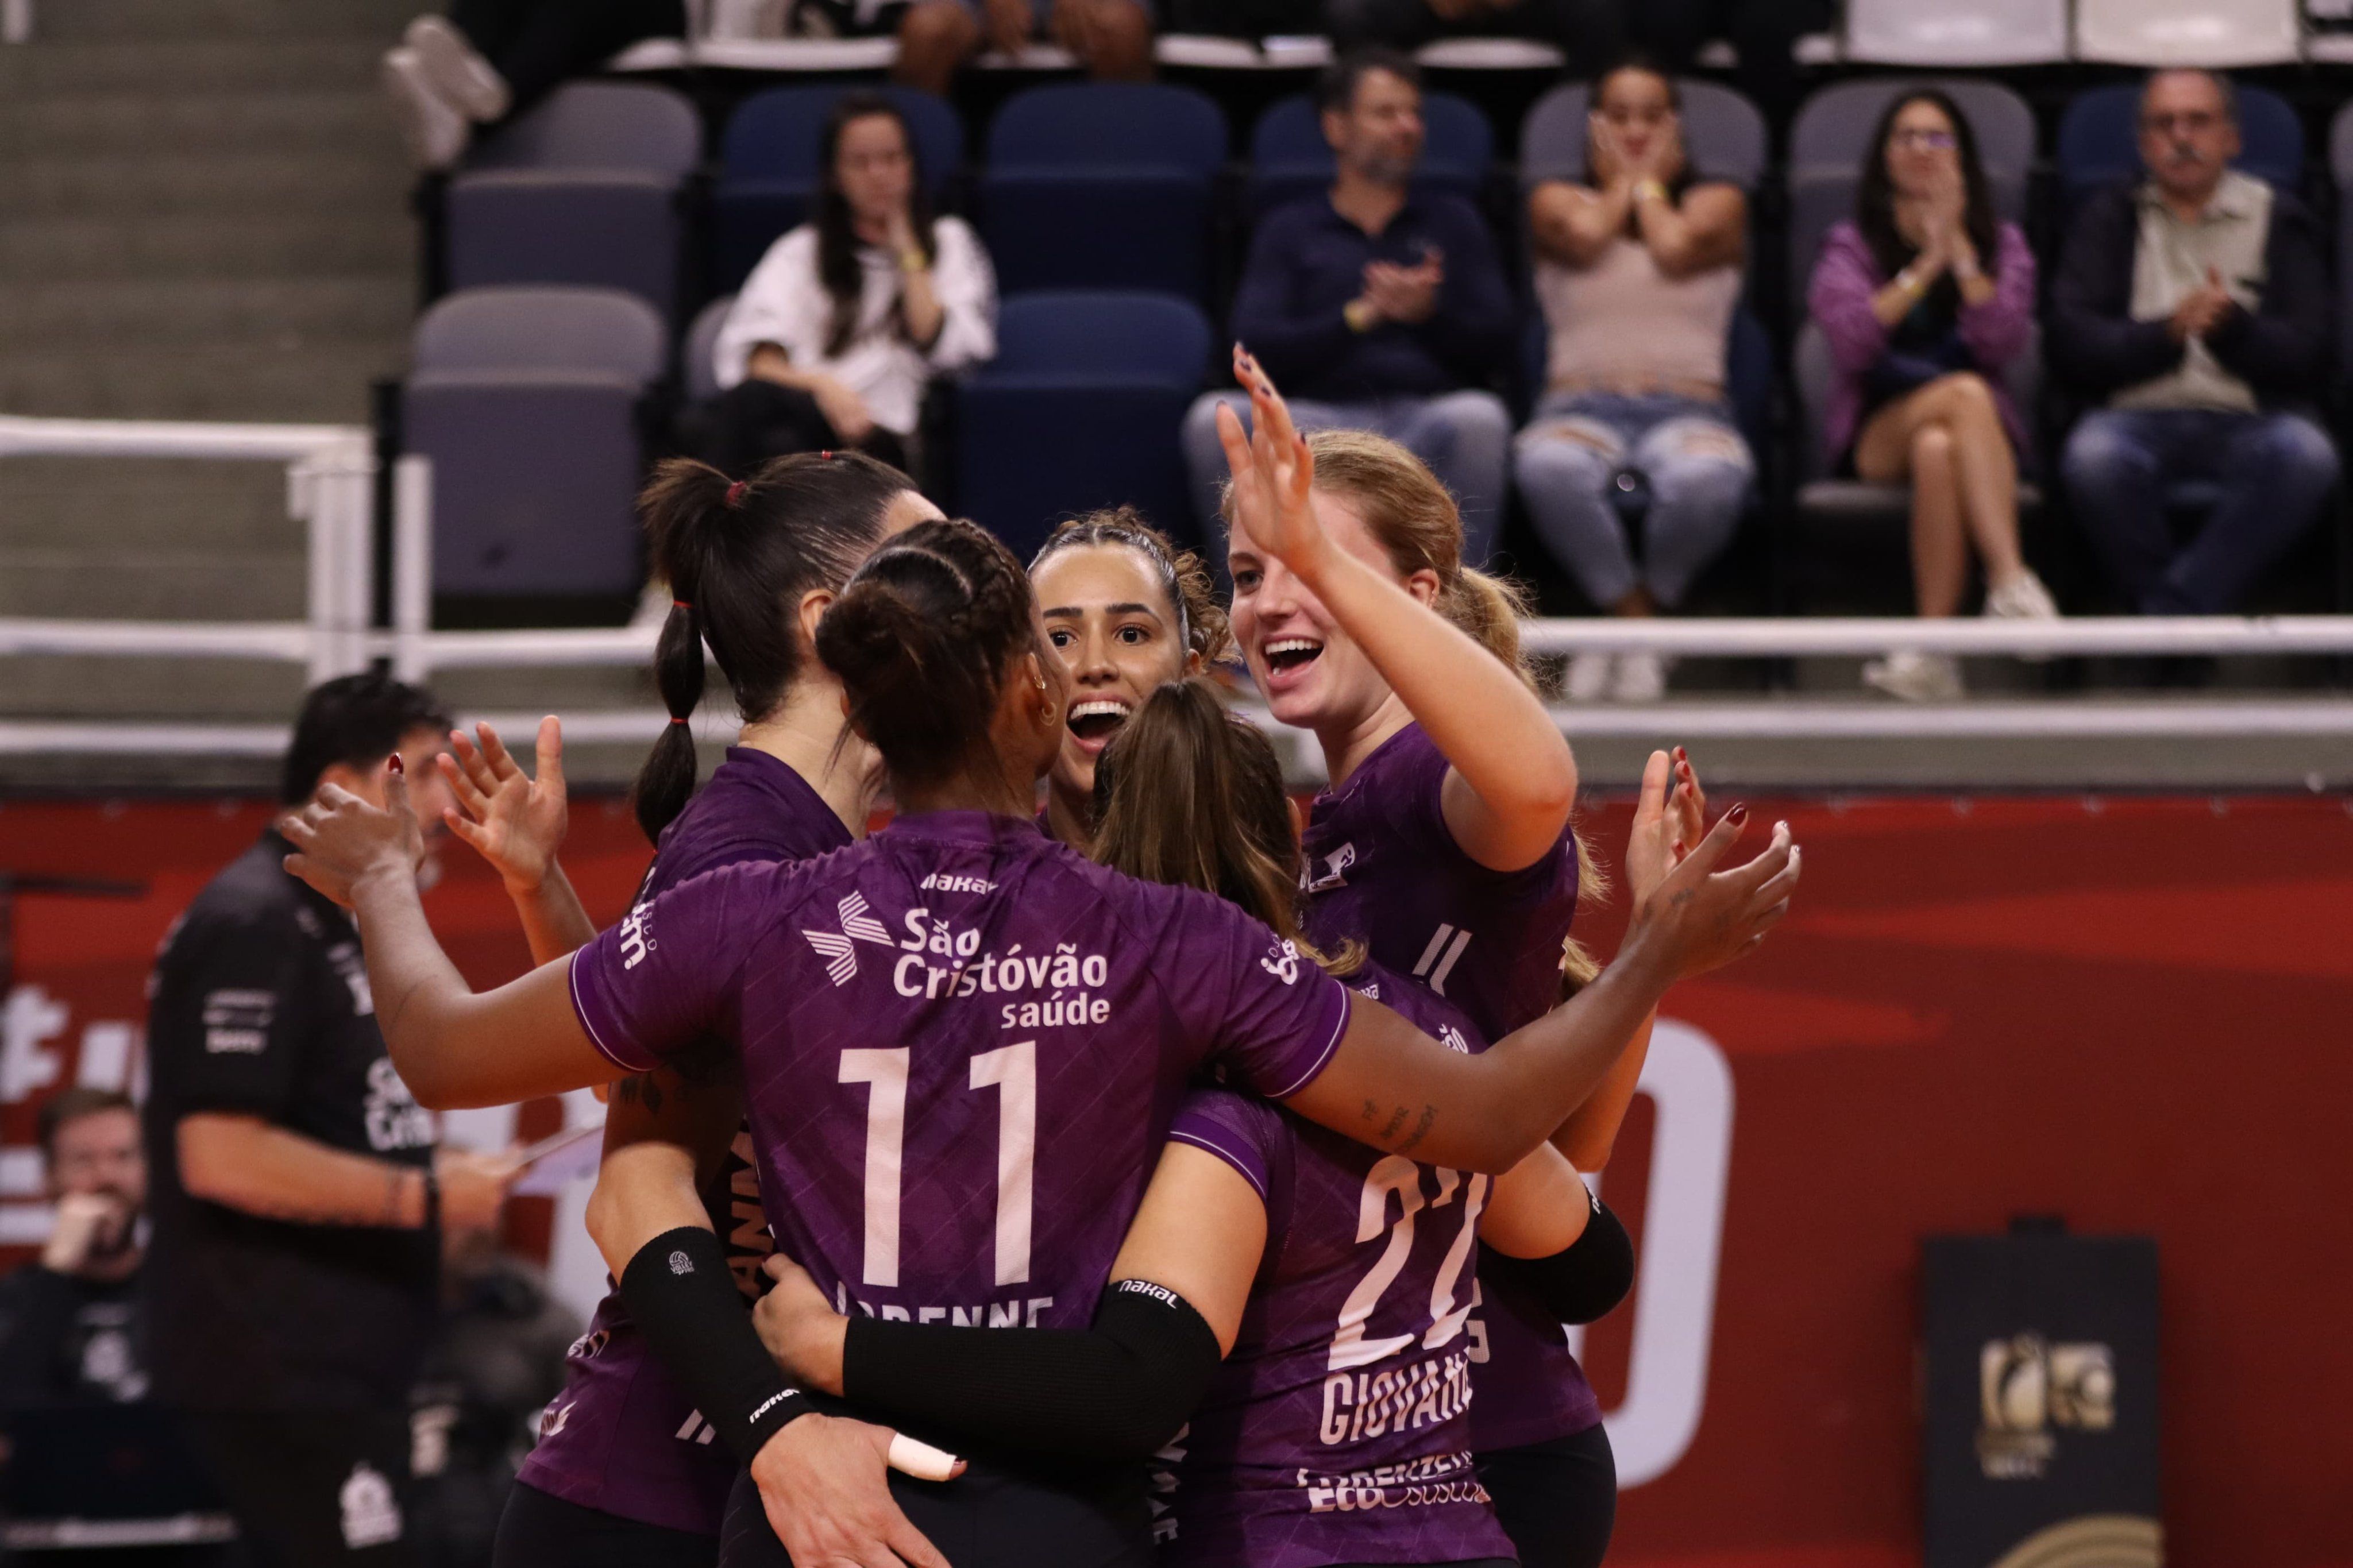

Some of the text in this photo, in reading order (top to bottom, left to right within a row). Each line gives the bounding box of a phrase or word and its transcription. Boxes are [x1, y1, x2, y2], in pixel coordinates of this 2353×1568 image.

[900, 907, 980, 957] São
[893, 943, 1108, 999] Cristóvão
[1001, 990, 1110, 1029] saúde
[837, 1040, 1036, 1288] 11
[1119, 1280, 1177, 1309] nakal
